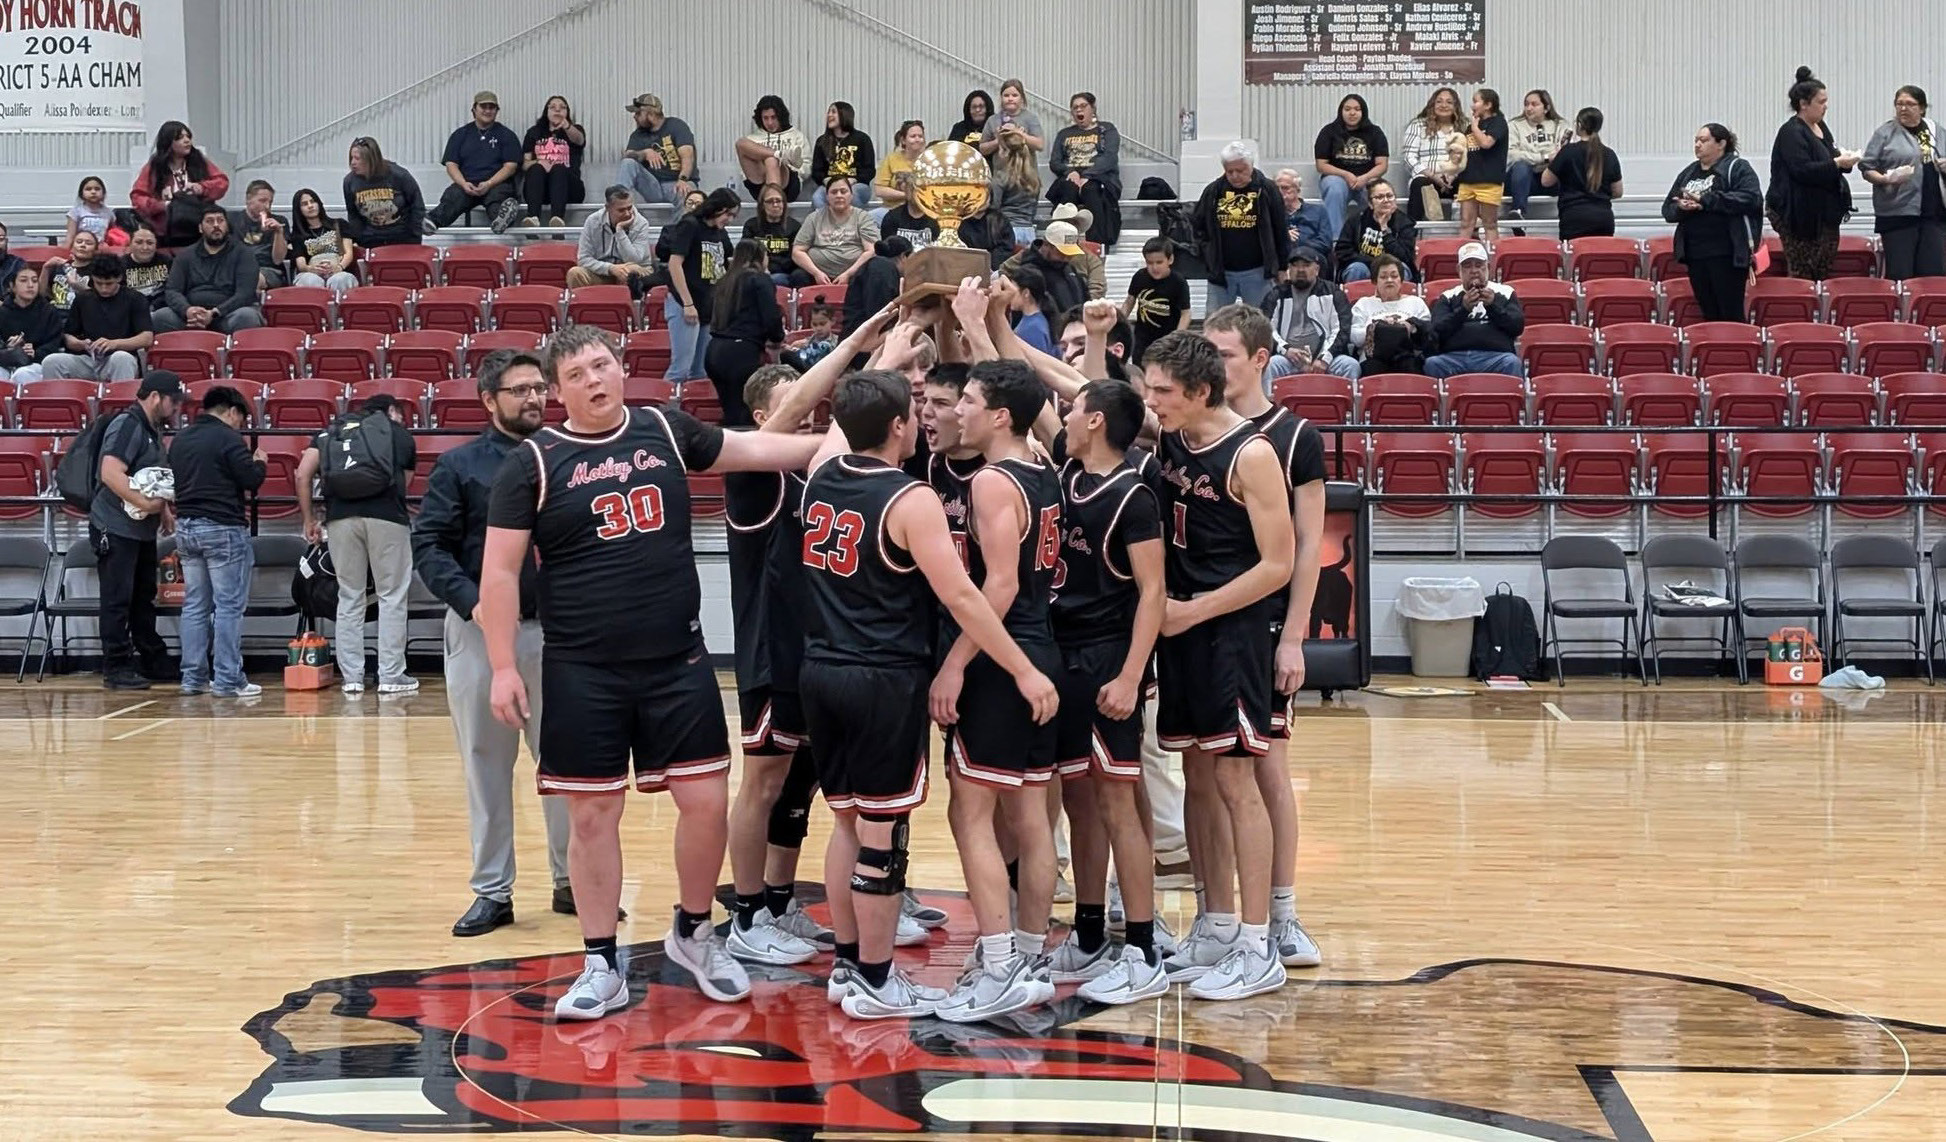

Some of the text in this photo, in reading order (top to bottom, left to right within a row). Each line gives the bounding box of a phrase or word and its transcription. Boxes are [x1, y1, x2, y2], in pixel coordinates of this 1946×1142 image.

[20, 0, 75, 30] HORN
[1406, 22, 1433, 31] Andrew
[1357, 23, 1388, 32] Johnson
[24, 36, 92, 55] 2004
[41, 63, 83, 89] 5-AA
[89, 62, 141, 88] CHAM
[0, 102, 32, 119] Qualifier
[70, 103, 111, 117] Podexer
[567, 449, 666, 488] Motley Co.
[1193, 474, 1220, 501] Co.
[591, 484, 665, 540] 30
[803, 500, 865, 577] 23
[1035, 503, 1060, 571] 15
[1068, 526, 1092, 555] Co.
[165, 570, 174, 581] G
[306, 654, 315, 664] G
[1791, 650, 1801, 660] G
[1790, 666, 1803, 681] G
